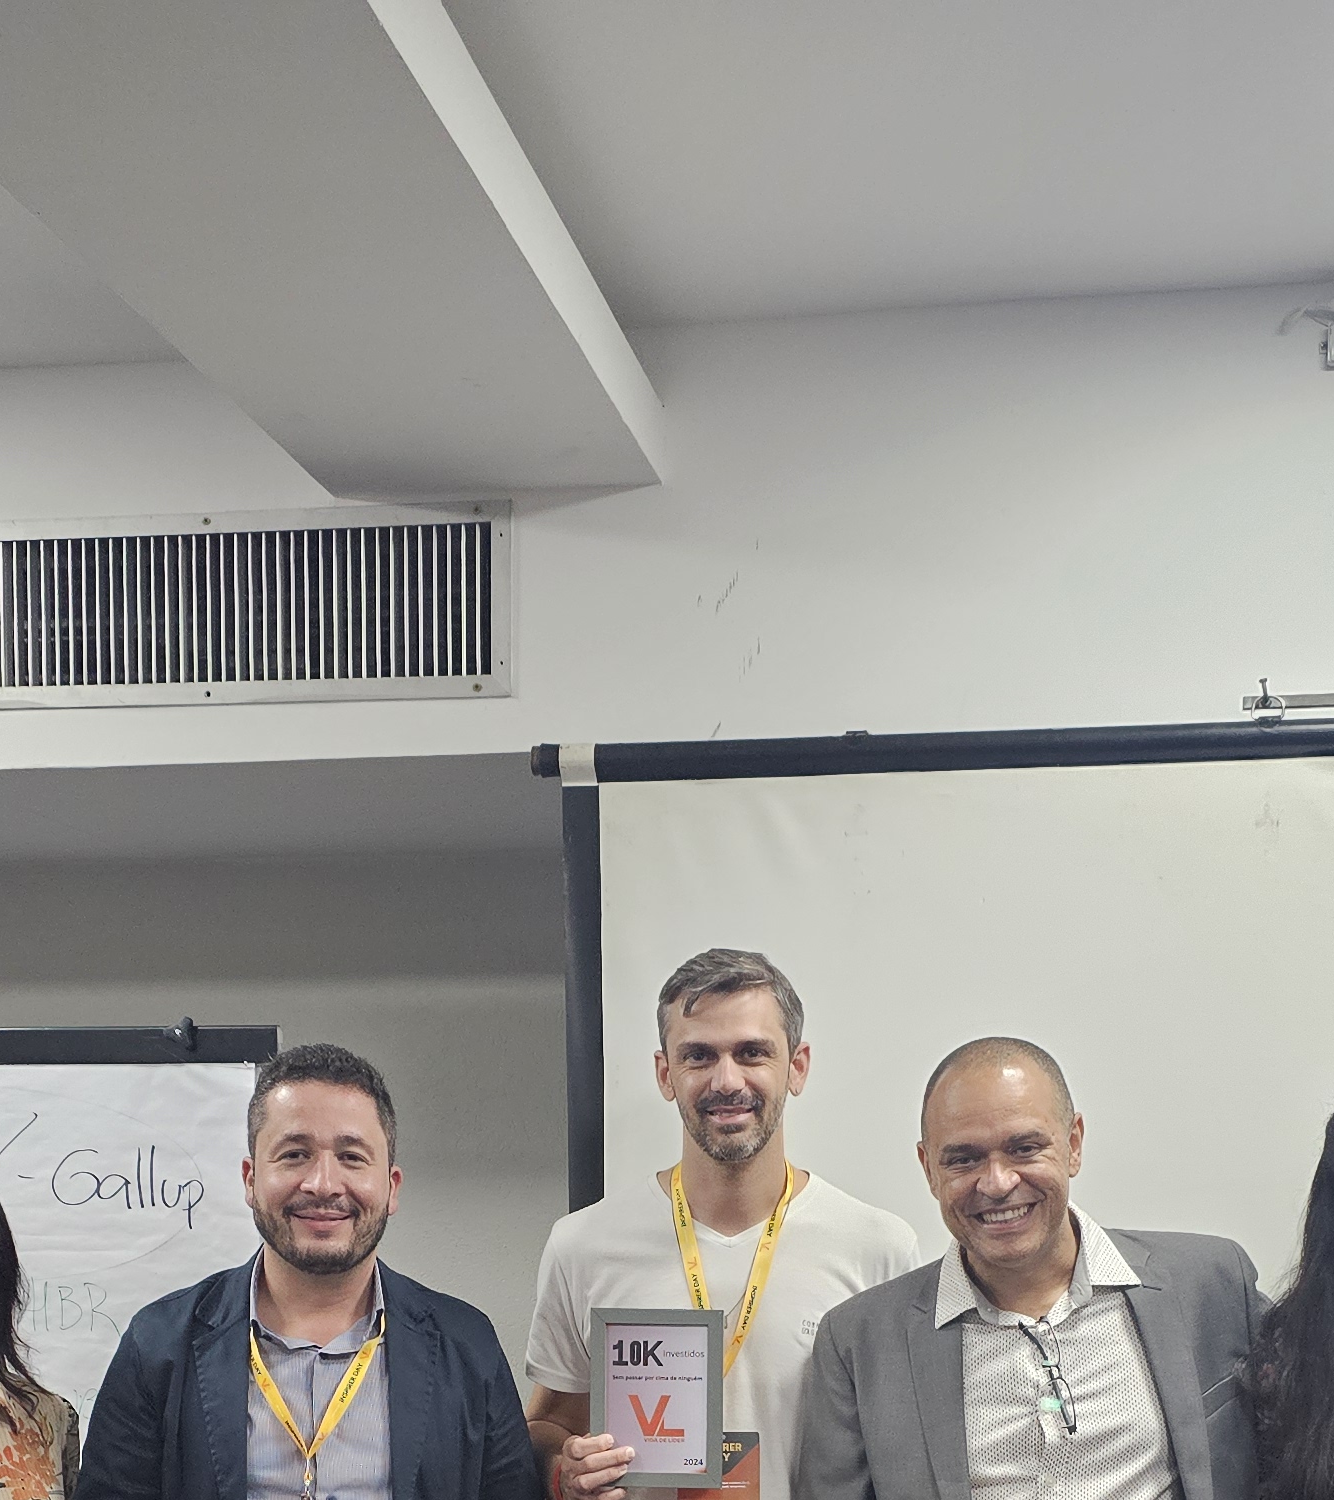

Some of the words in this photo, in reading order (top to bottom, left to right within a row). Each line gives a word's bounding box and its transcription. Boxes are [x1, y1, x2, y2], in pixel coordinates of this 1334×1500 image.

[51, 1145, 205, 1230] Gallup
[26, 1277, 121, 1336] HBR
[353, 1363, 363, 1376] DAY
[612, 1339, 663, 1367] 10K
[663, 1350, 704, 1358] Investidos
[628, 1395, 685, 1437] VL
[684, 1458, 703, 1466] 2024
